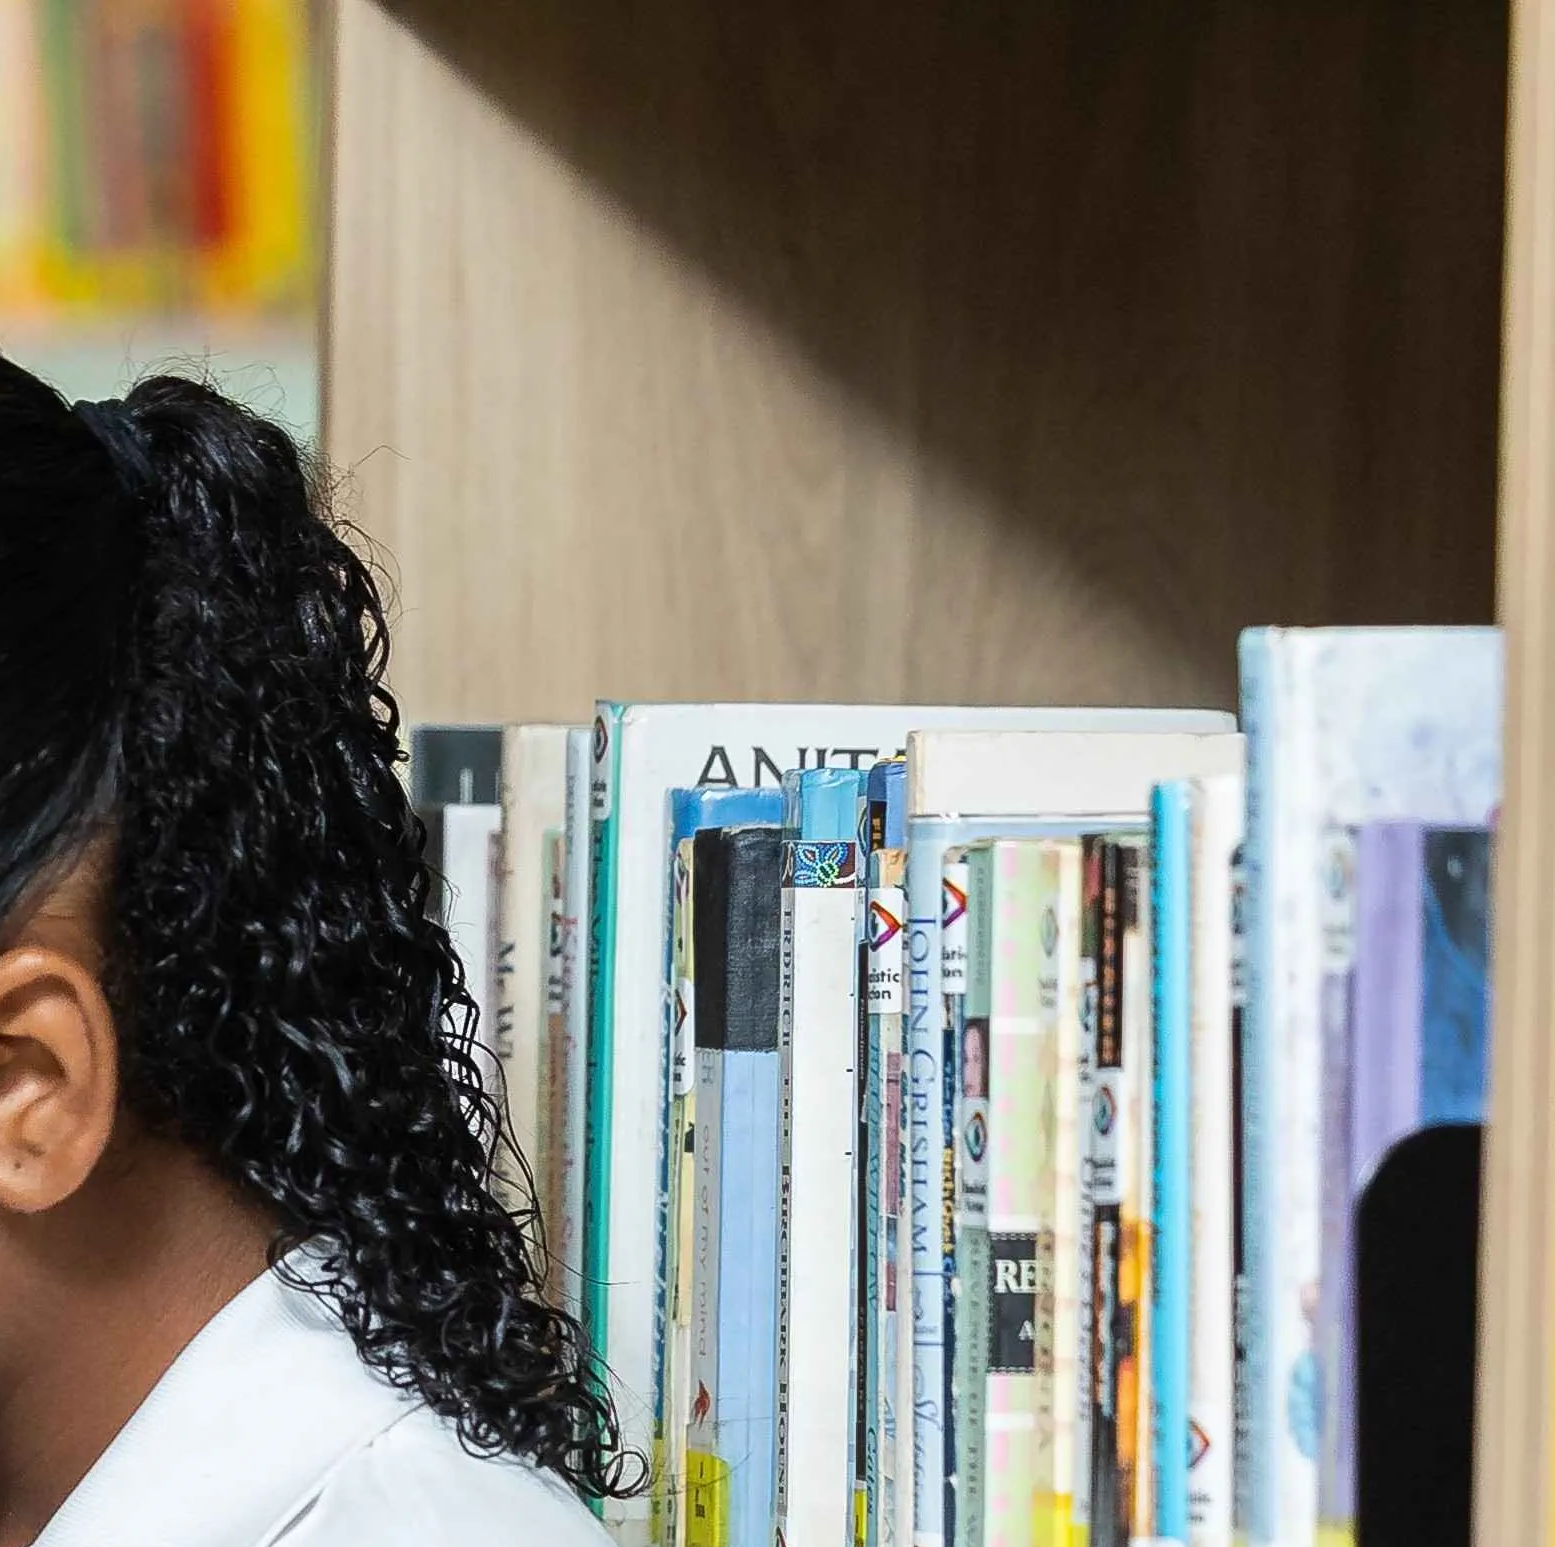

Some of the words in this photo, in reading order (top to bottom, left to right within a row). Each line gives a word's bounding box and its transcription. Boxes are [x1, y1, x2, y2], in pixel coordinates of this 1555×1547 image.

[697, 745, 906, 788] ANIT
[907, 917, 937, 1034] JOHN
[911, 1050, 938, 1254] GRISHAM
[698, 1281, 709, 1358] mind
